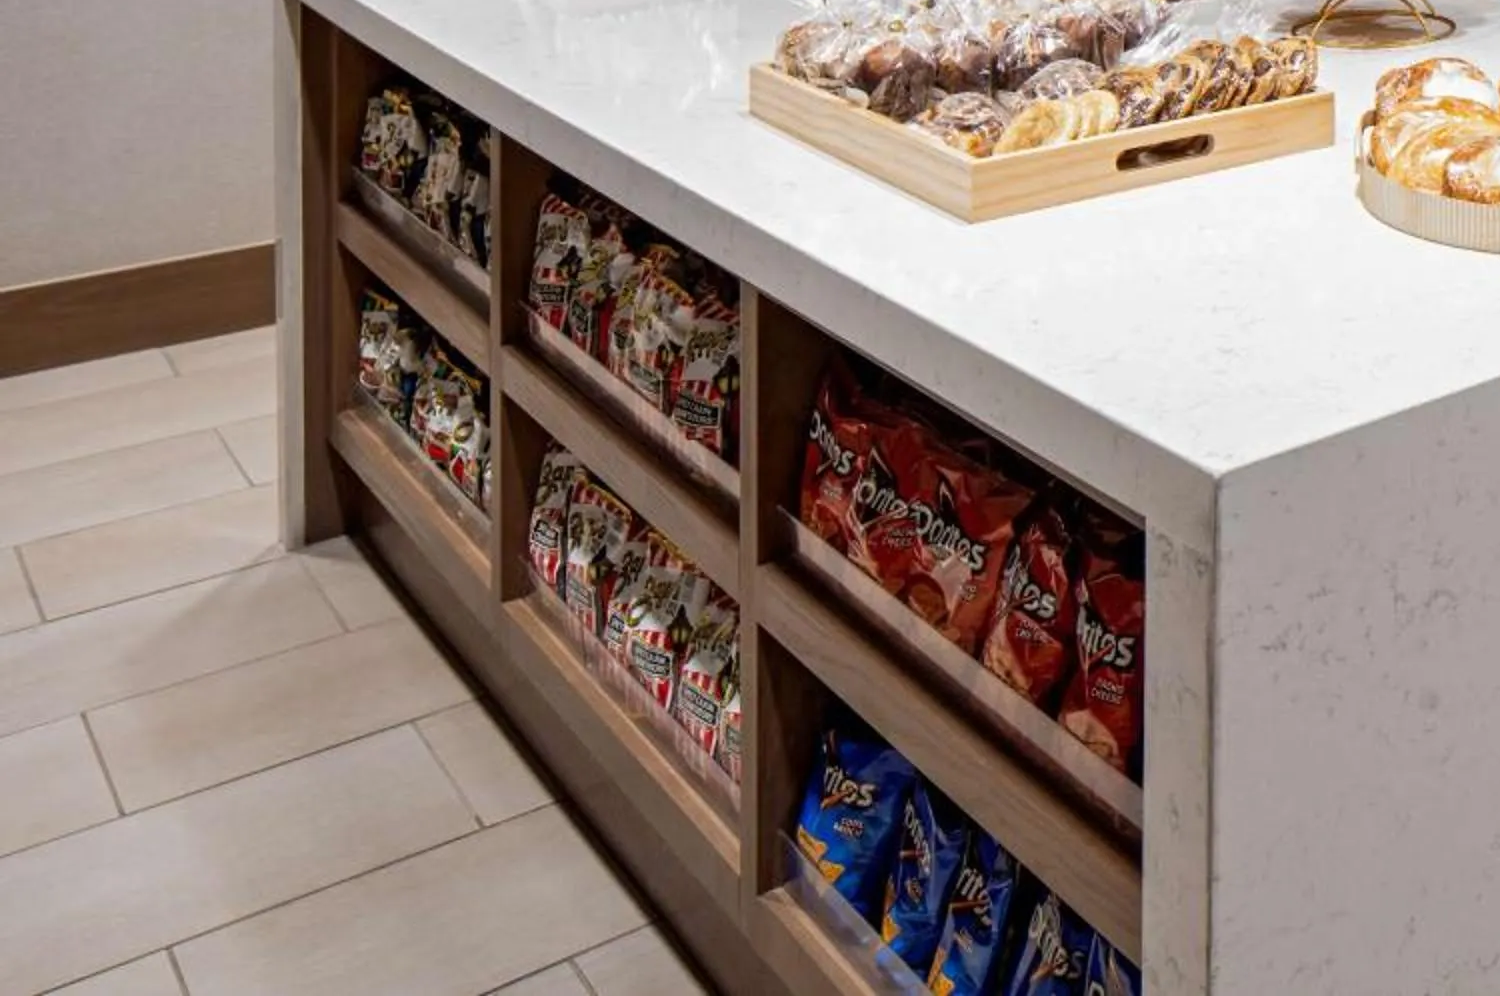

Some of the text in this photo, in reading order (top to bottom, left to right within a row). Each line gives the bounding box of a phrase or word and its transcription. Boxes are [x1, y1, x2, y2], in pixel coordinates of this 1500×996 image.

[856, 469, 909, 520] orito
[1077, 604, 1136, 668] ritos
[823, 766, 877, 808] ritos
